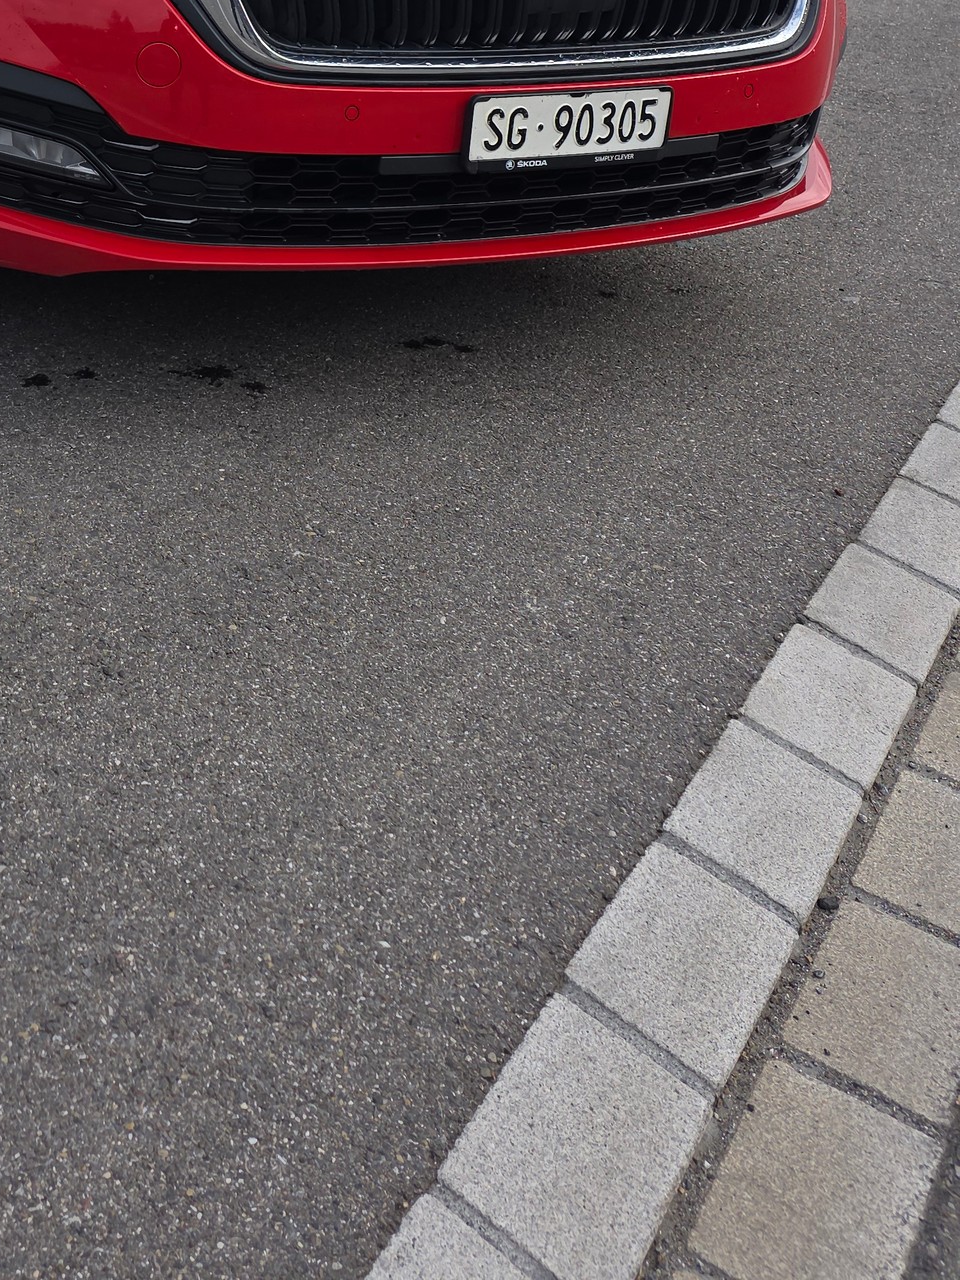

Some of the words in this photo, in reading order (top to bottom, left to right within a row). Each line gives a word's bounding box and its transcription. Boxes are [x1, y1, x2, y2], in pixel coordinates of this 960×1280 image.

[594, 155, 614, 163] SIMPLY
[614, 153, 634, 161] CLEVER
[517, 159, 548, 168] ŠKODA
